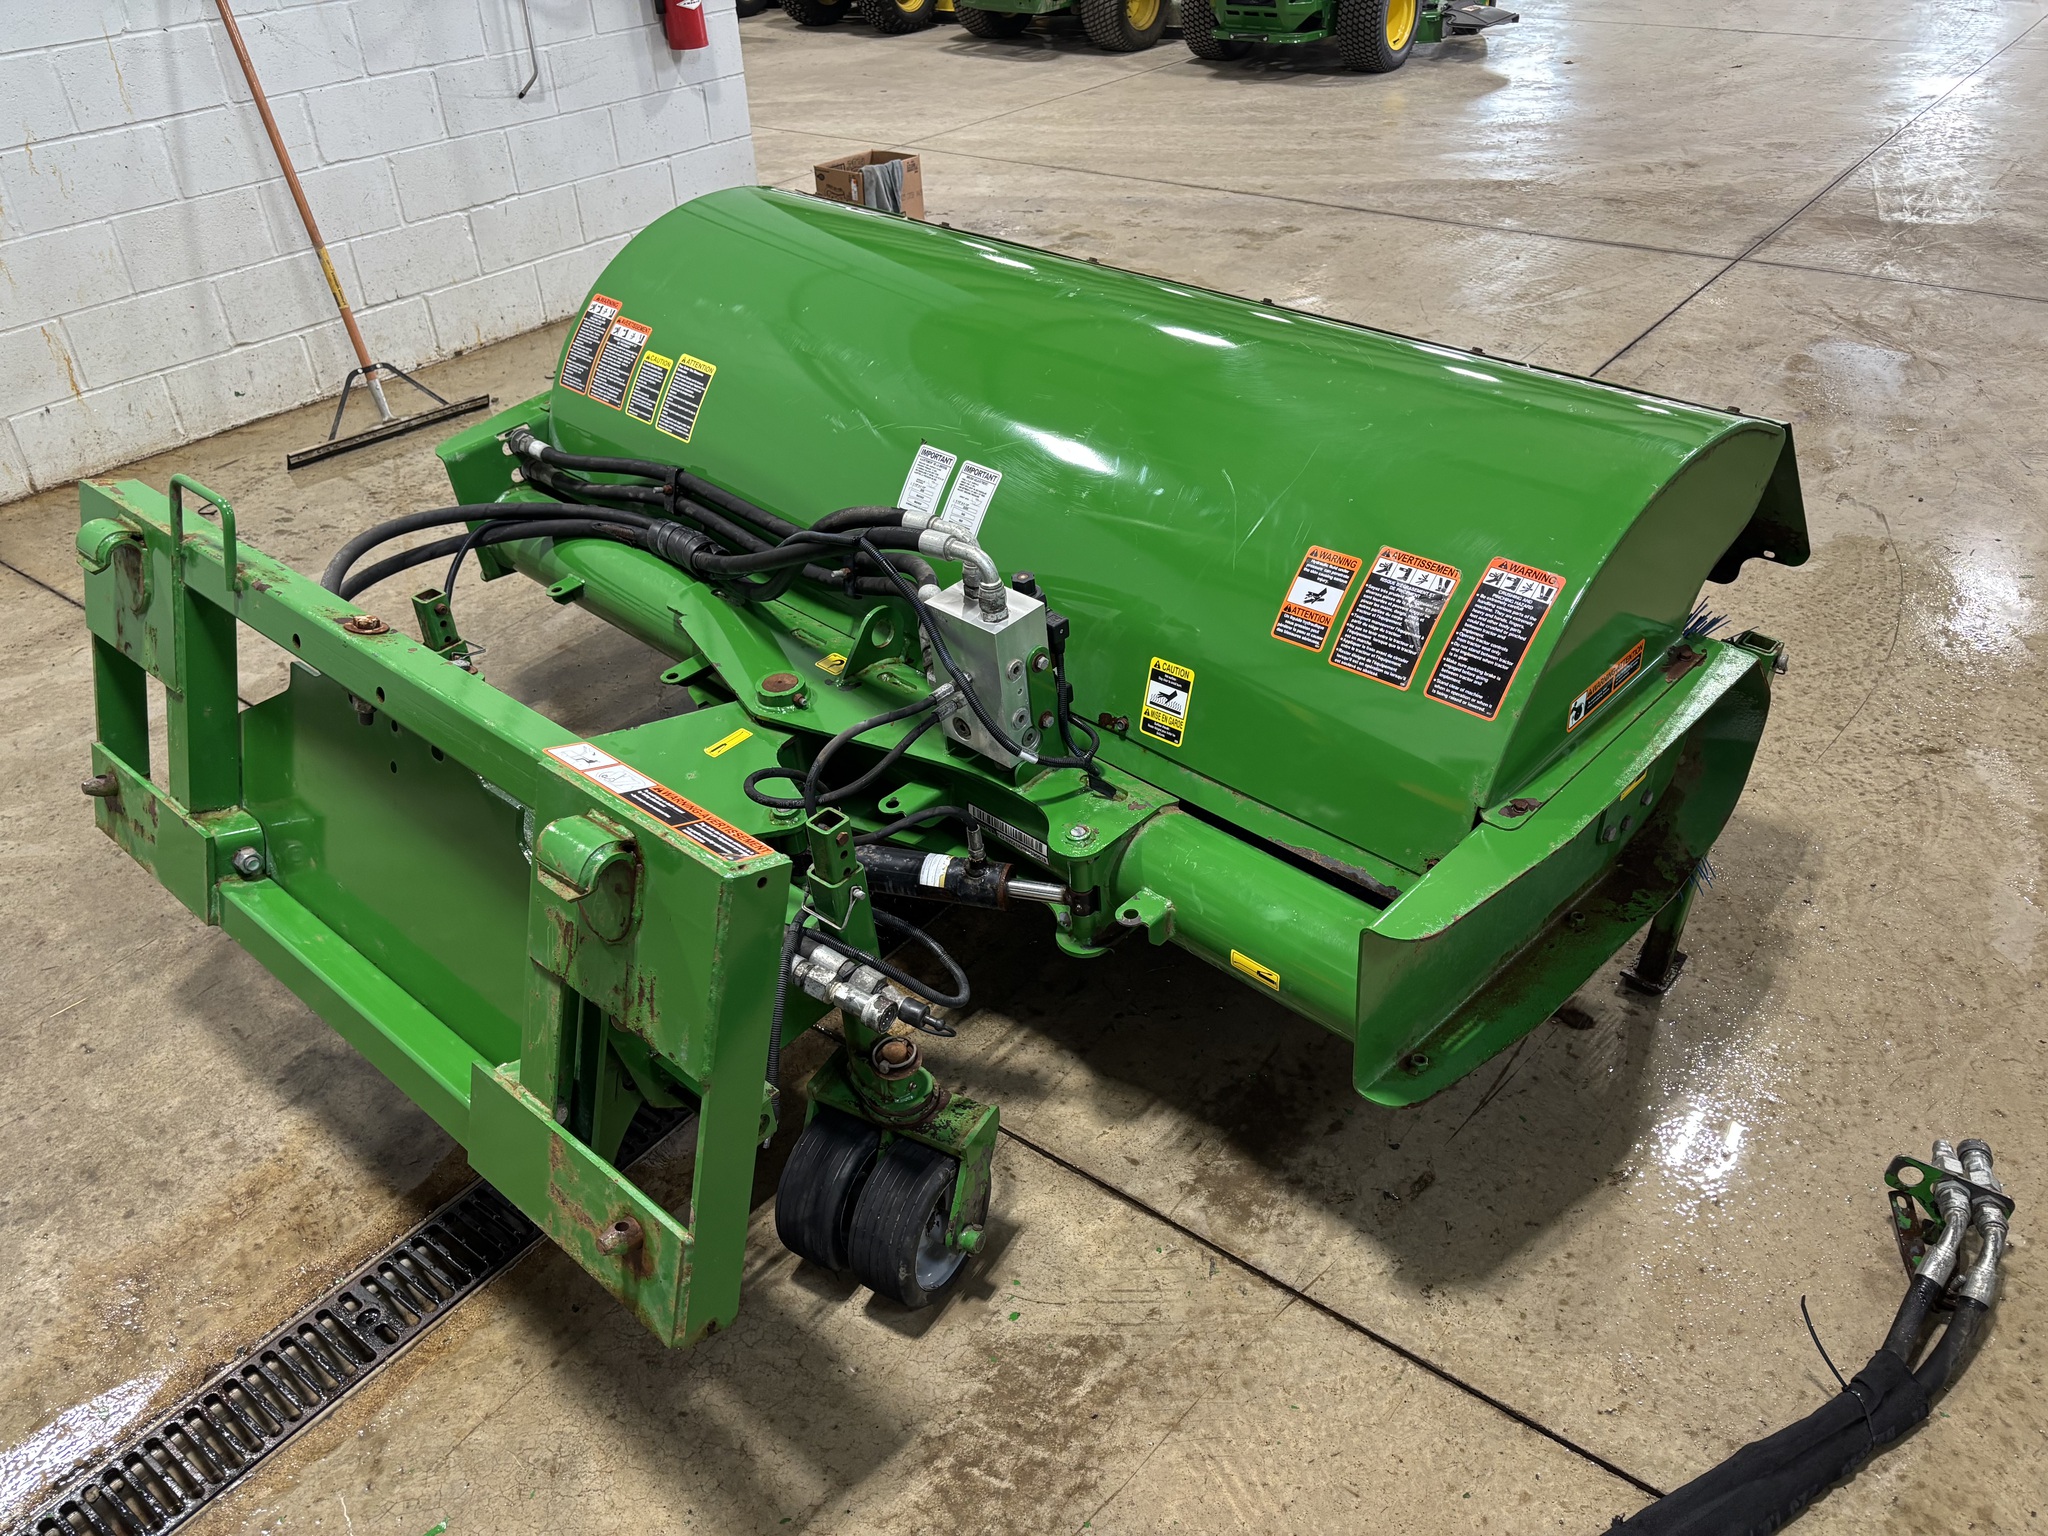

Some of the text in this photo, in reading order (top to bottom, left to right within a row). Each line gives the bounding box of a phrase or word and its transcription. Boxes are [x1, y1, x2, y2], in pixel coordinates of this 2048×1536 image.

[650, 354, 671, 368] CAUTION
[686, 358, 715, 374] ATTENTION
[921, 448, 953, 465] IMPORTANT
[964, 465, 998, 482] IMPORTANT
[1319, 551, 1357, 568] WARNING
[1392, 552, 1459, 577] AVERTISSEMENT
[1510, 563, 1556, 584] WARNING
[1492, 593, 1533, 610] PINCHING HAZARD
[1498, 590, 1522, 600] CRUSHING
[1291, 606, 1331, 624] ATTENTION
[1162, 662, 1190, 679] CAUTION
[1150, 710, 1184, 730] MISE EN GARDE
